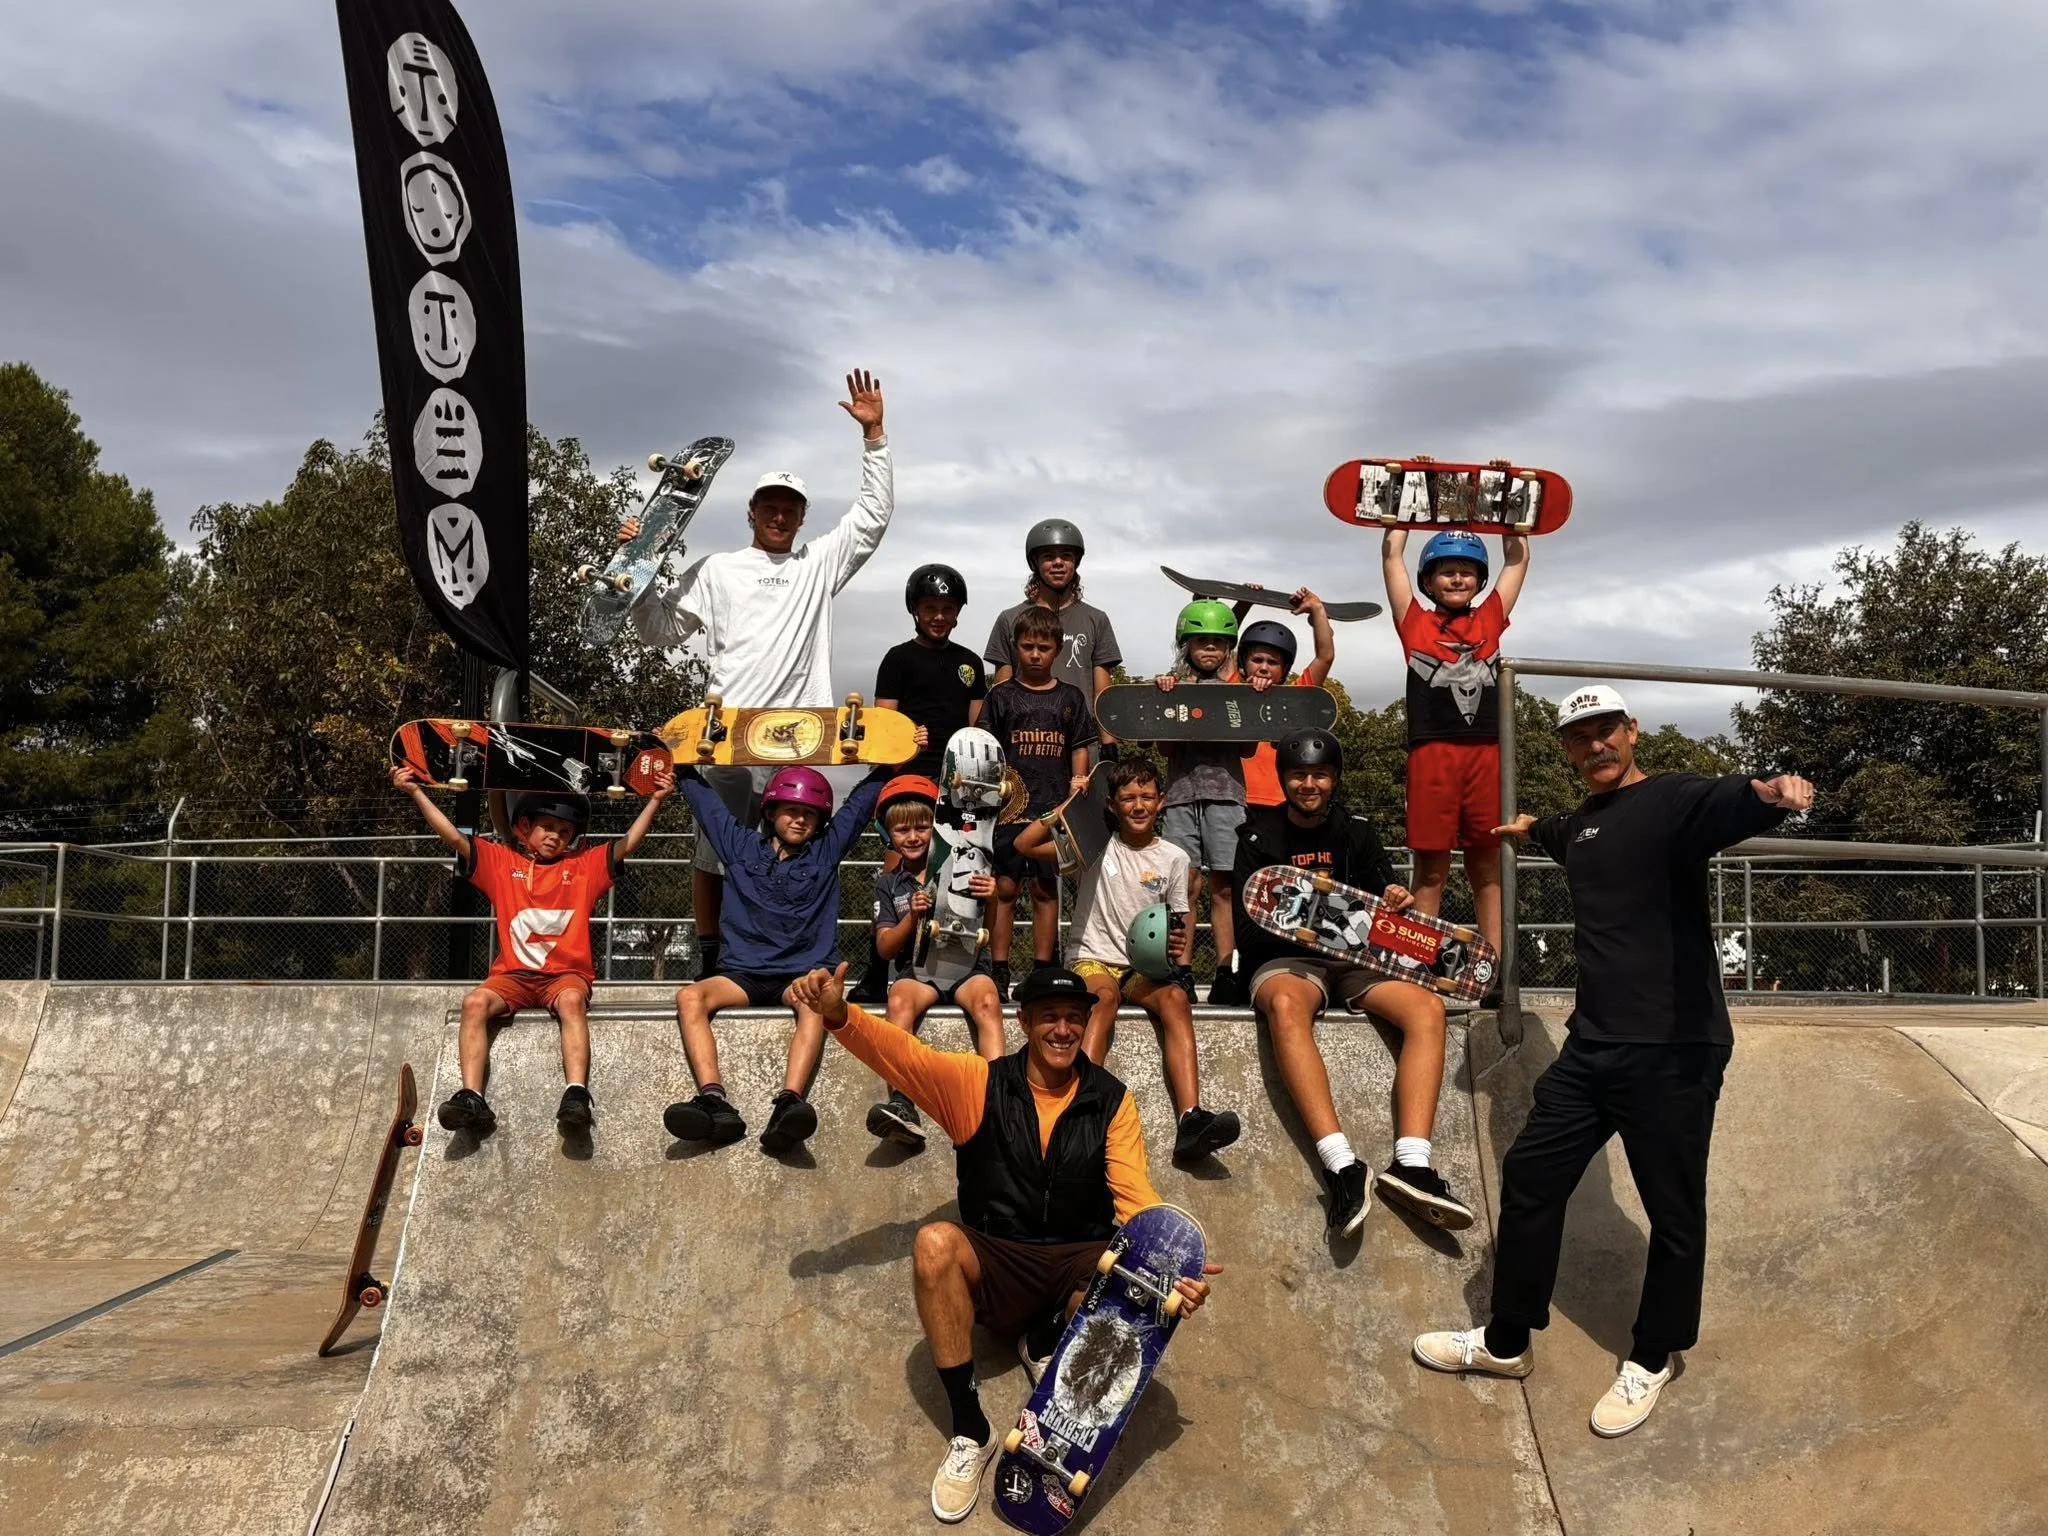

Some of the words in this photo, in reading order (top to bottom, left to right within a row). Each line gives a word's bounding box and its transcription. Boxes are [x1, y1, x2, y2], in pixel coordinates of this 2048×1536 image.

[756, 577, 789, 585] TOTEM
[1570, 694, 1598, 708] VANS
[1019, 744, 1033, 756] FLY
[1035, 744, 1063, 757] BETTER
[1291, 853, 1315, 866] TOP
[1398, 926, 1437, 947] SUNS
